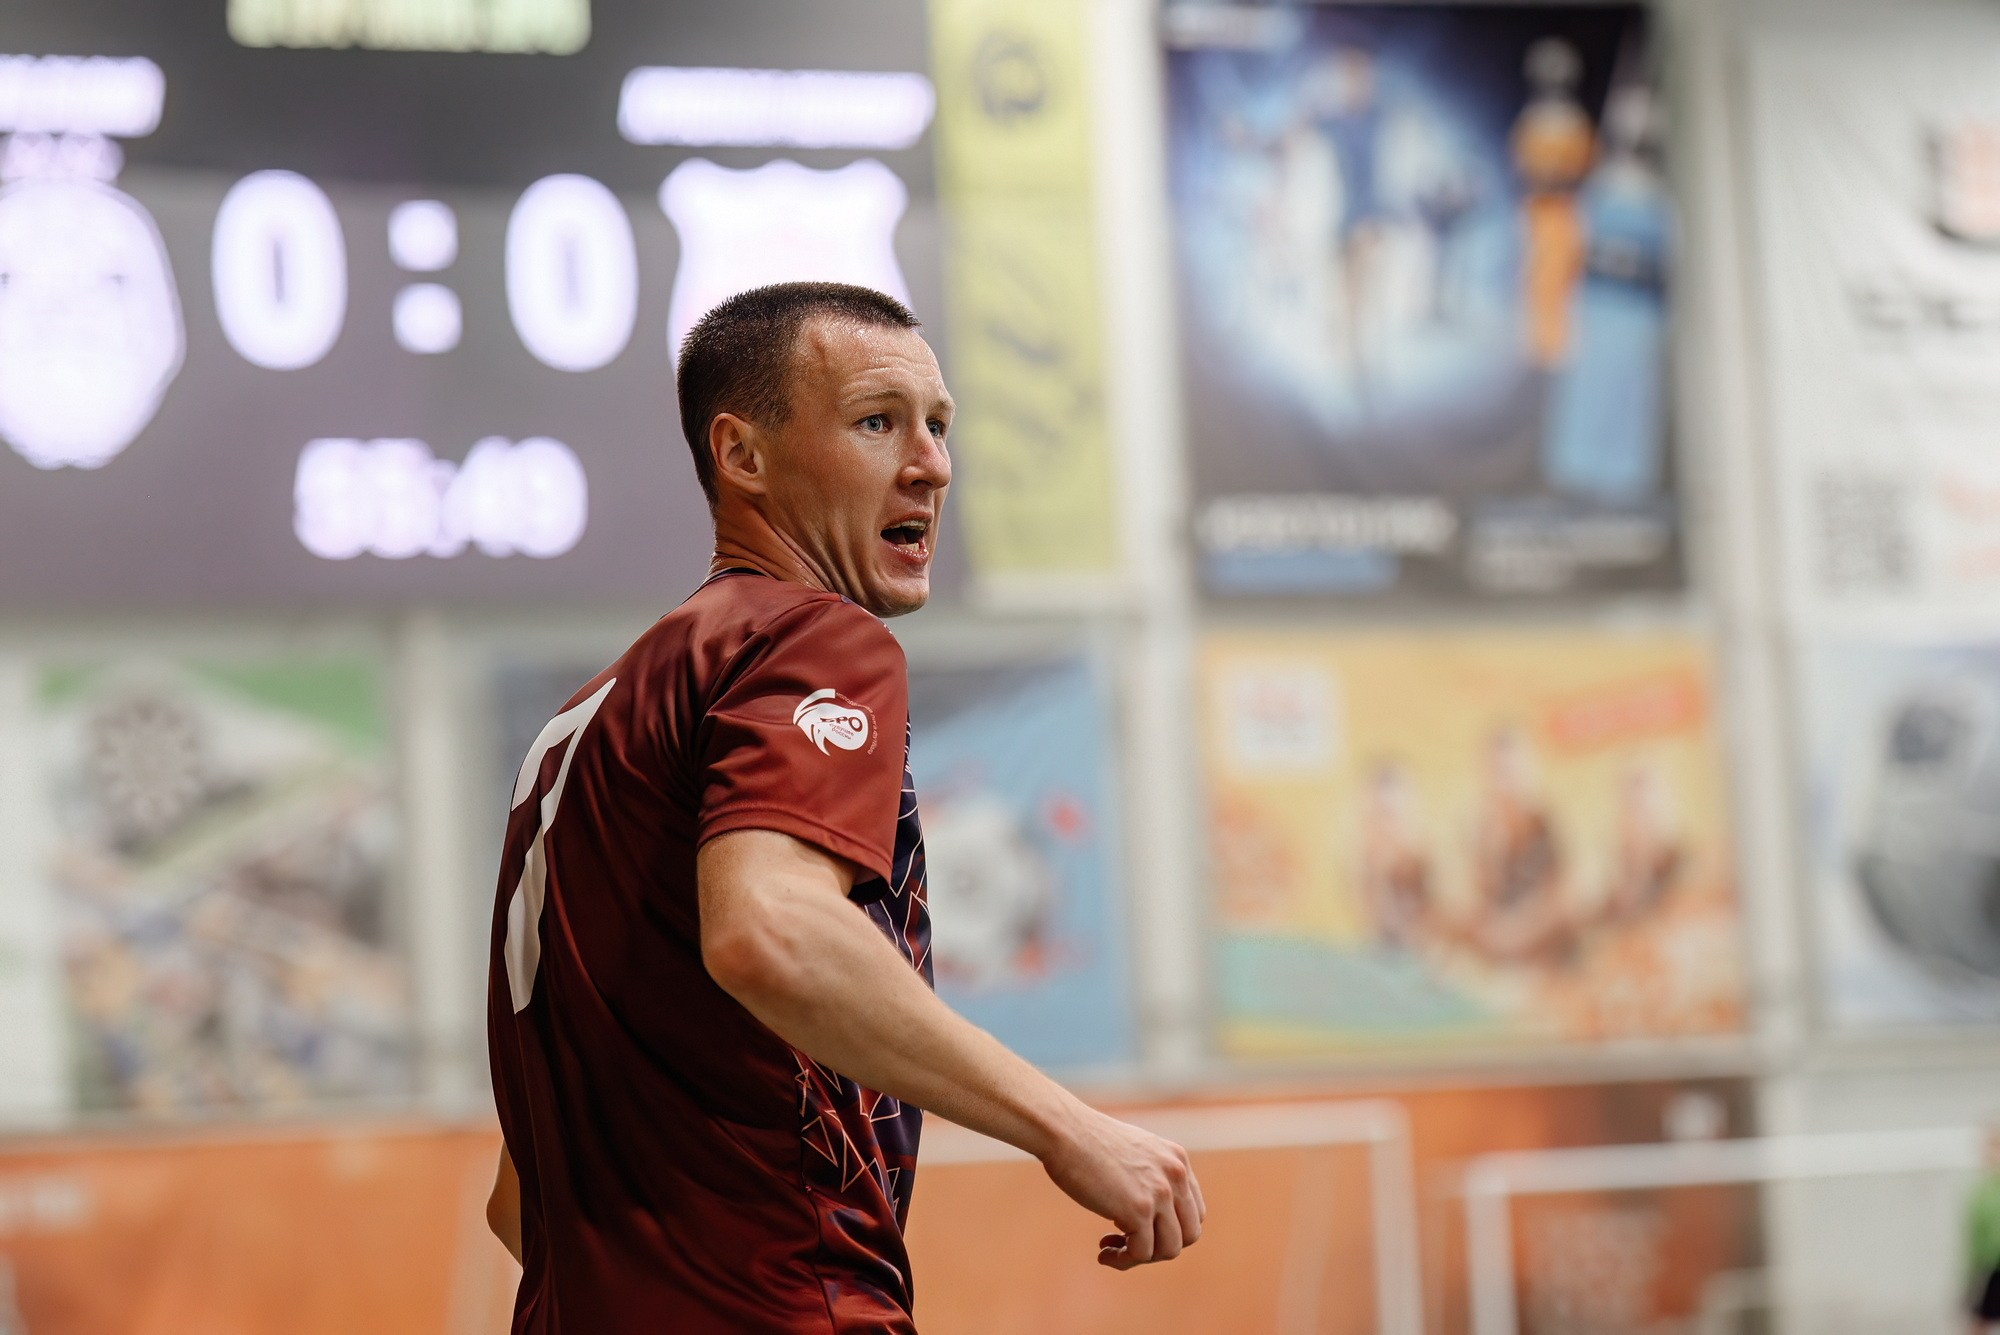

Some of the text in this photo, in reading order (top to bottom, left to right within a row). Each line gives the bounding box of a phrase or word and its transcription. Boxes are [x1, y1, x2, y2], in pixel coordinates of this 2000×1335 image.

[211, 169, 347, 371] 0
[505, 173, 638, 372] 0
[503, 676, 617, 1015] 7
